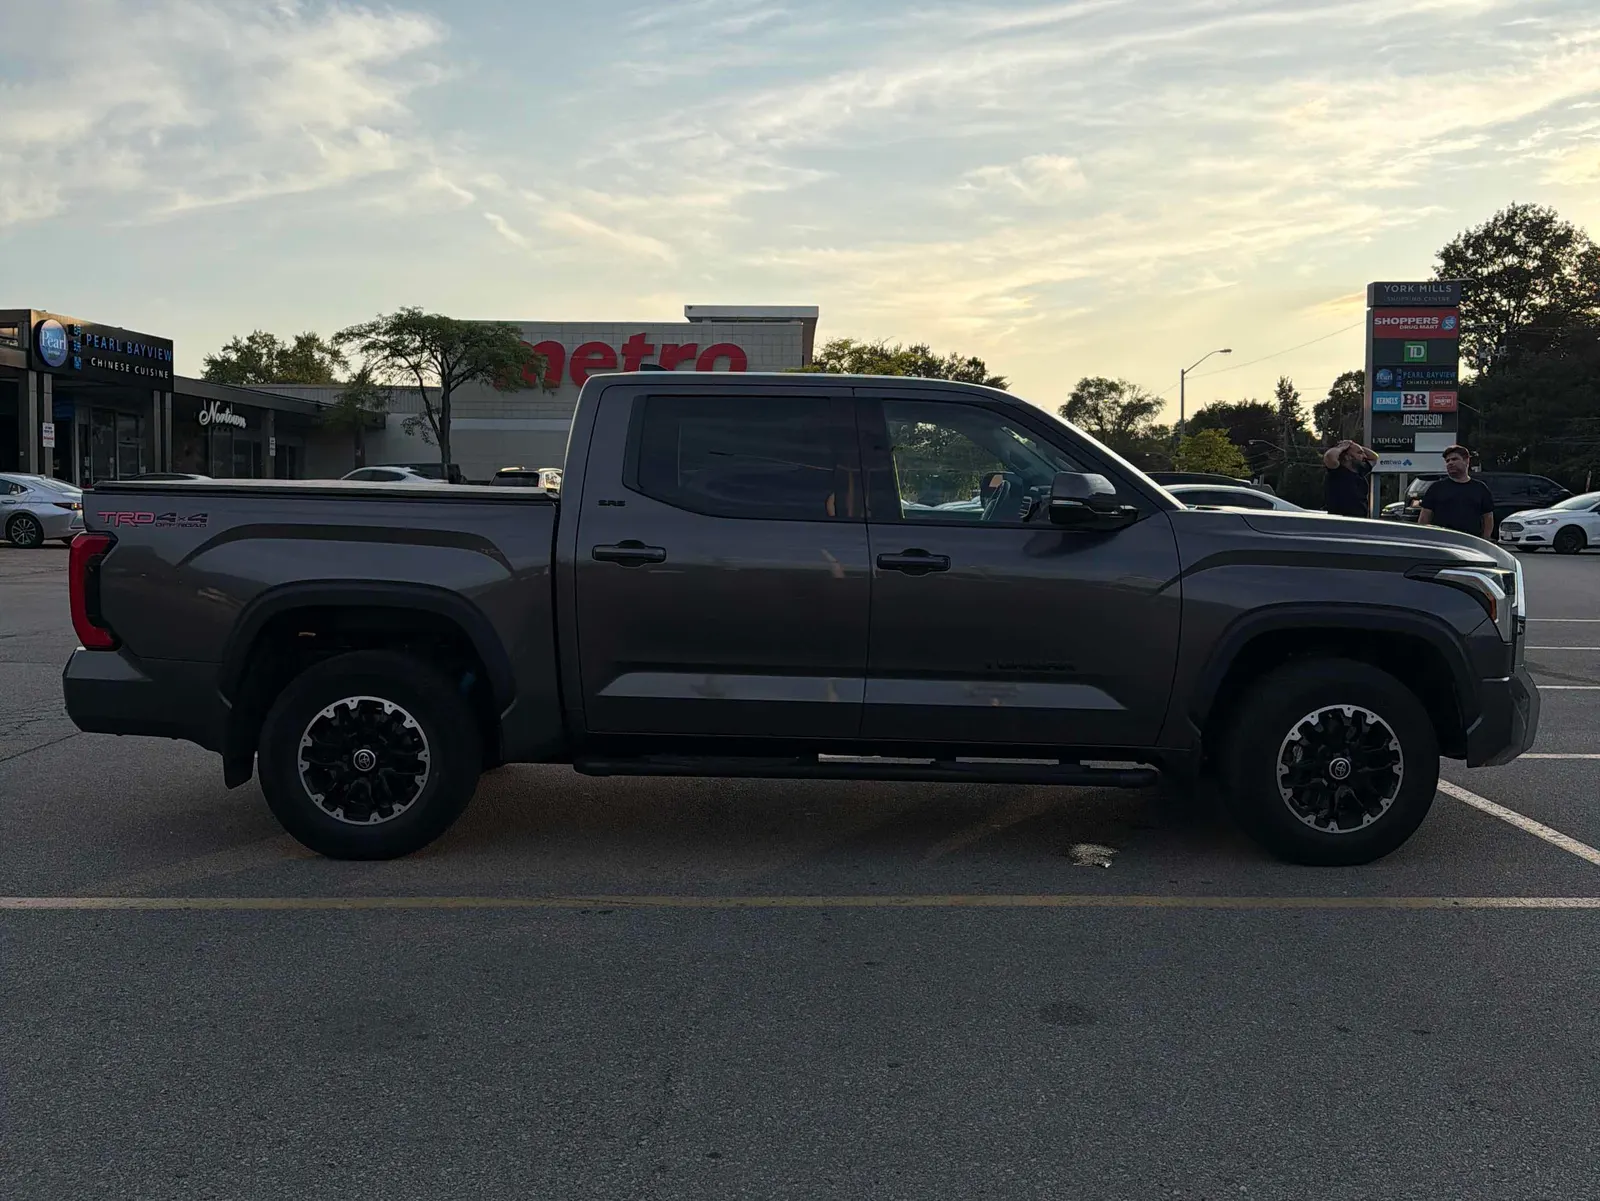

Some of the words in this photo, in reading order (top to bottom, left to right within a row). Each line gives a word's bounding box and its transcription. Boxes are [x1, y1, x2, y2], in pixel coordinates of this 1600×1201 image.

[1384, 284, 1415, 293] YORK
[1419, 284, 1452, 293] MILLS
[1374, 317, 1439, 325] SHOPPERS
[41, 330, 66, 350] Pearl
[86, 333, 122, 352] PEARL
[127, 341, 172, 362] BAYVIEW
[1406, 345, 1425, 358] TD
[91, 357, 130, 373] CHINESE
[134, 365, 169, 379] CUISINE
[1402, 371, 1424, 379] PEARL
[1426, 371, 1456, 379] BAYVIEW
[1376, 397, 1398, 405] KERNELS
[1402, 414, 1443, 426] JOSEPHSON
[97, 511, 156, 527] TRD
